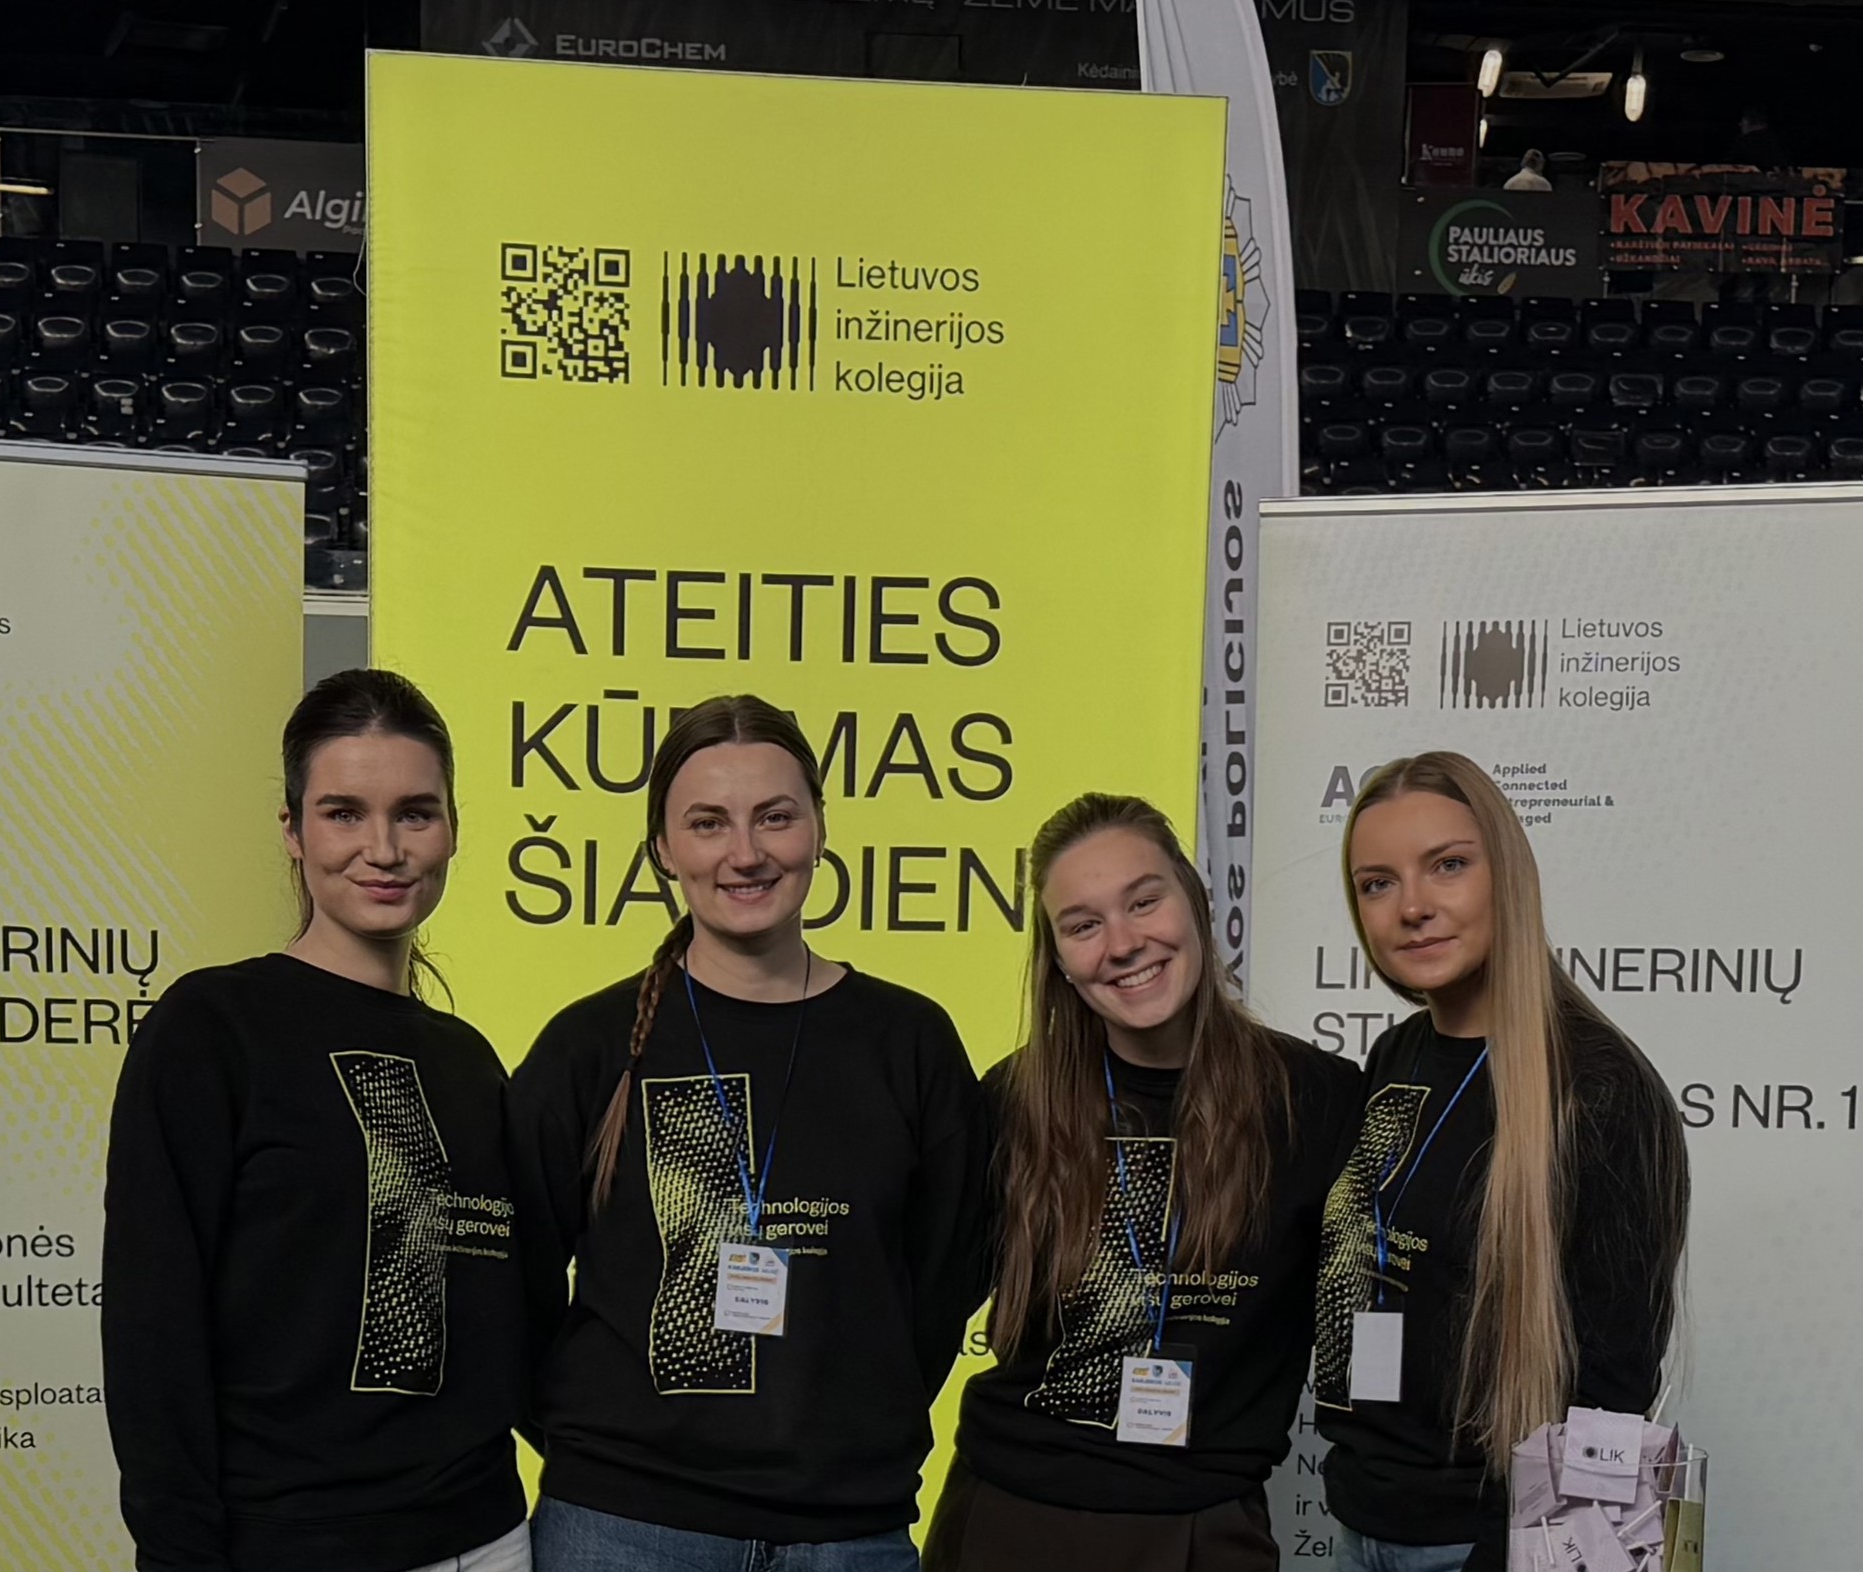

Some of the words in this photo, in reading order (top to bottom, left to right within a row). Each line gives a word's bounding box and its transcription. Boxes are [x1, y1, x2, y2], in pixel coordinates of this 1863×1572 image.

[1609, 183, 1835, 238] KAVINĖ
[1447, 225, 1545, 247] PAULIAUS
[1446, 245, 1577, 267] STALIORIAUS
[835, 255, 980, 293] Lietuvos
[835, 309, 1005, 350] inžinerijos
[835, 361, 965, 401] kolegija
[506, 564, 1002, 668] ATEITIES
[1560, 616, 1664, 640] Lietuvos
[1559, 650, 1681, 676] inžinerijos
[1558, 685, 1652, 711] kolegija
[509, 689, 1015, 801] KŪMAS
[1492, 763, 1547, 778] Applied
[1496, 779, 1568, 792] onnected
[1604, 795, 1615, 807] &
[504, 814, 1028, 933] ŠIADIEN
[1556, 947, 1804, 1005] NERINIŲ
[1732, 1085, 1826, 1130] NR.
[1841, 1085, 1859, 1130] 1
[456, 1219, 511, 1238] gerovei
[765, 1219, 829, 1240] gerovei
[1170, 1291, 1238, 1310] gerovei
[1599, 1446, 1625, 1465] LIK
[1294, 1492, 1314, 1517] ir
